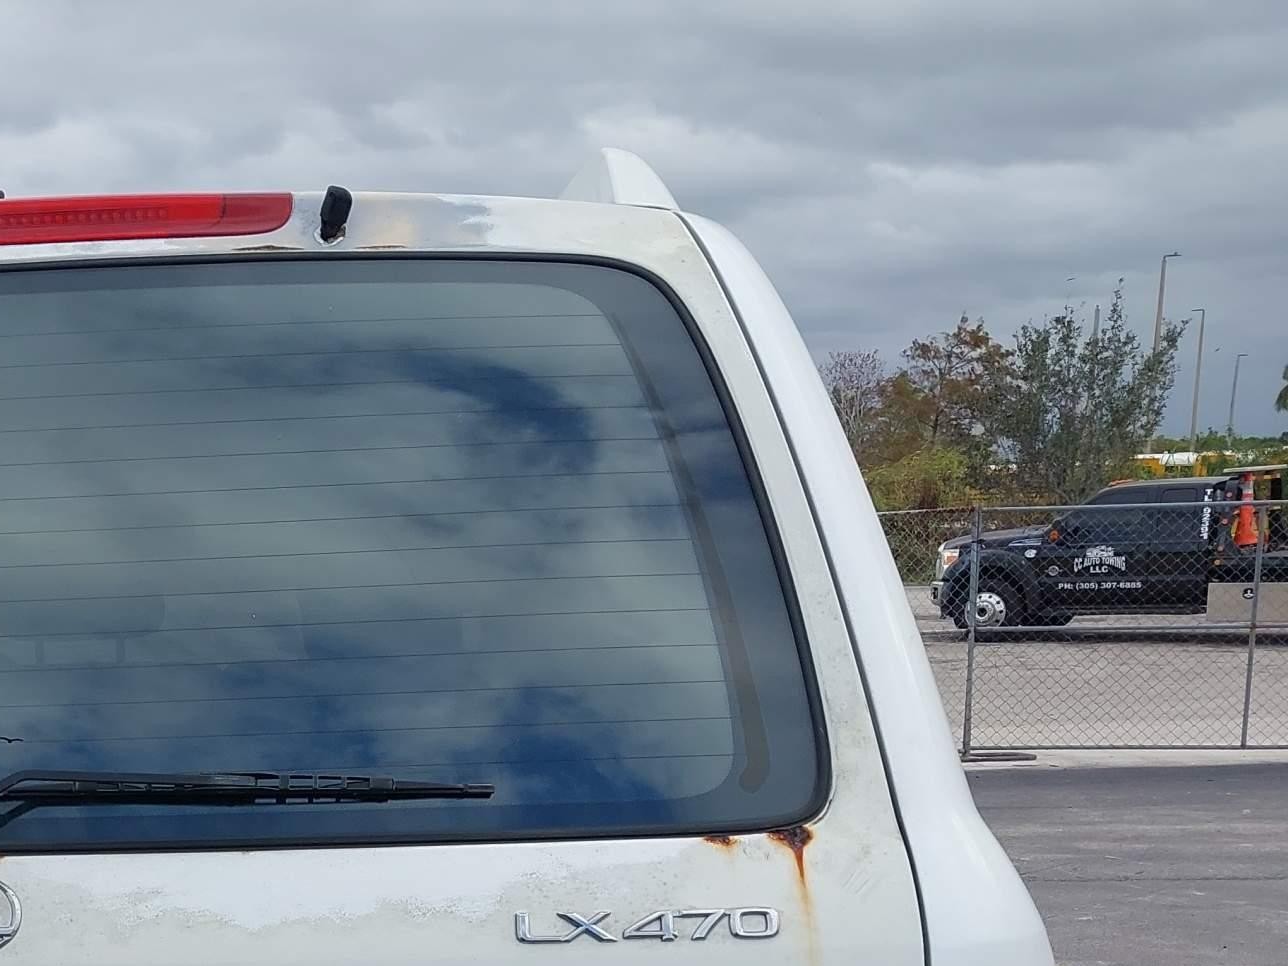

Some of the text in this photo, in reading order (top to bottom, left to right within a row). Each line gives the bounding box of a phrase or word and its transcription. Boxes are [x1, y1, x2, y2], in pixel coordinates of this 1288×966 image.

[1083, 557, 1100, 567] AUTO
[1102, 556, 1126, 571] TOWING
[1076, 582, 1098, 590] (305)
[515, 907, 781, 943] LX 470
